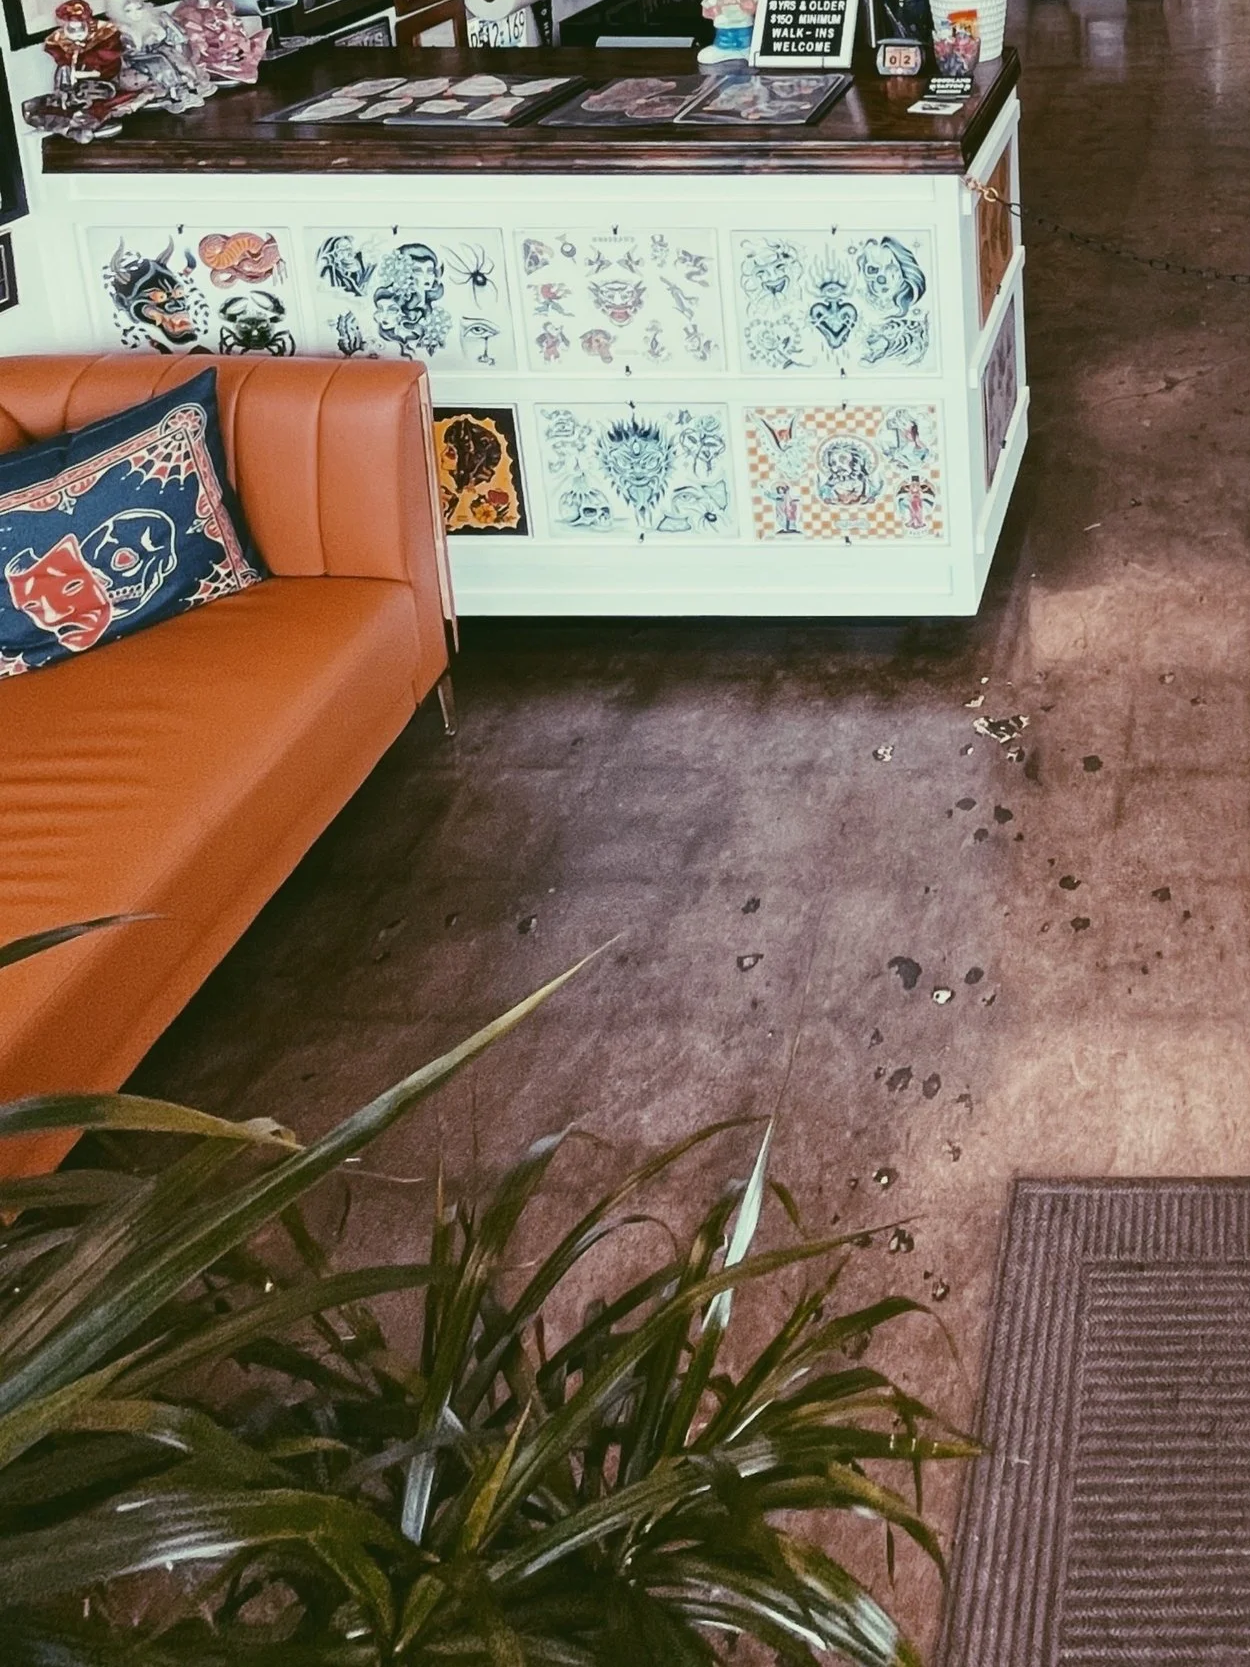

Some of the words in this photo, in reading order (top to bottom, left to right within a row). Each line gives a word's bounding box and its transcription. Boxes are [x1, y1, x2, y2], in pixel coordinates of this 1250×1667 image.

[799, 0, 807, 11] &
[809, 0, 845, 11] OLDER
[770, 14, 793, 24] $150
[799, 14, 841, 24] MINIMUM
[773, 41, 831, 53] WELCOME
